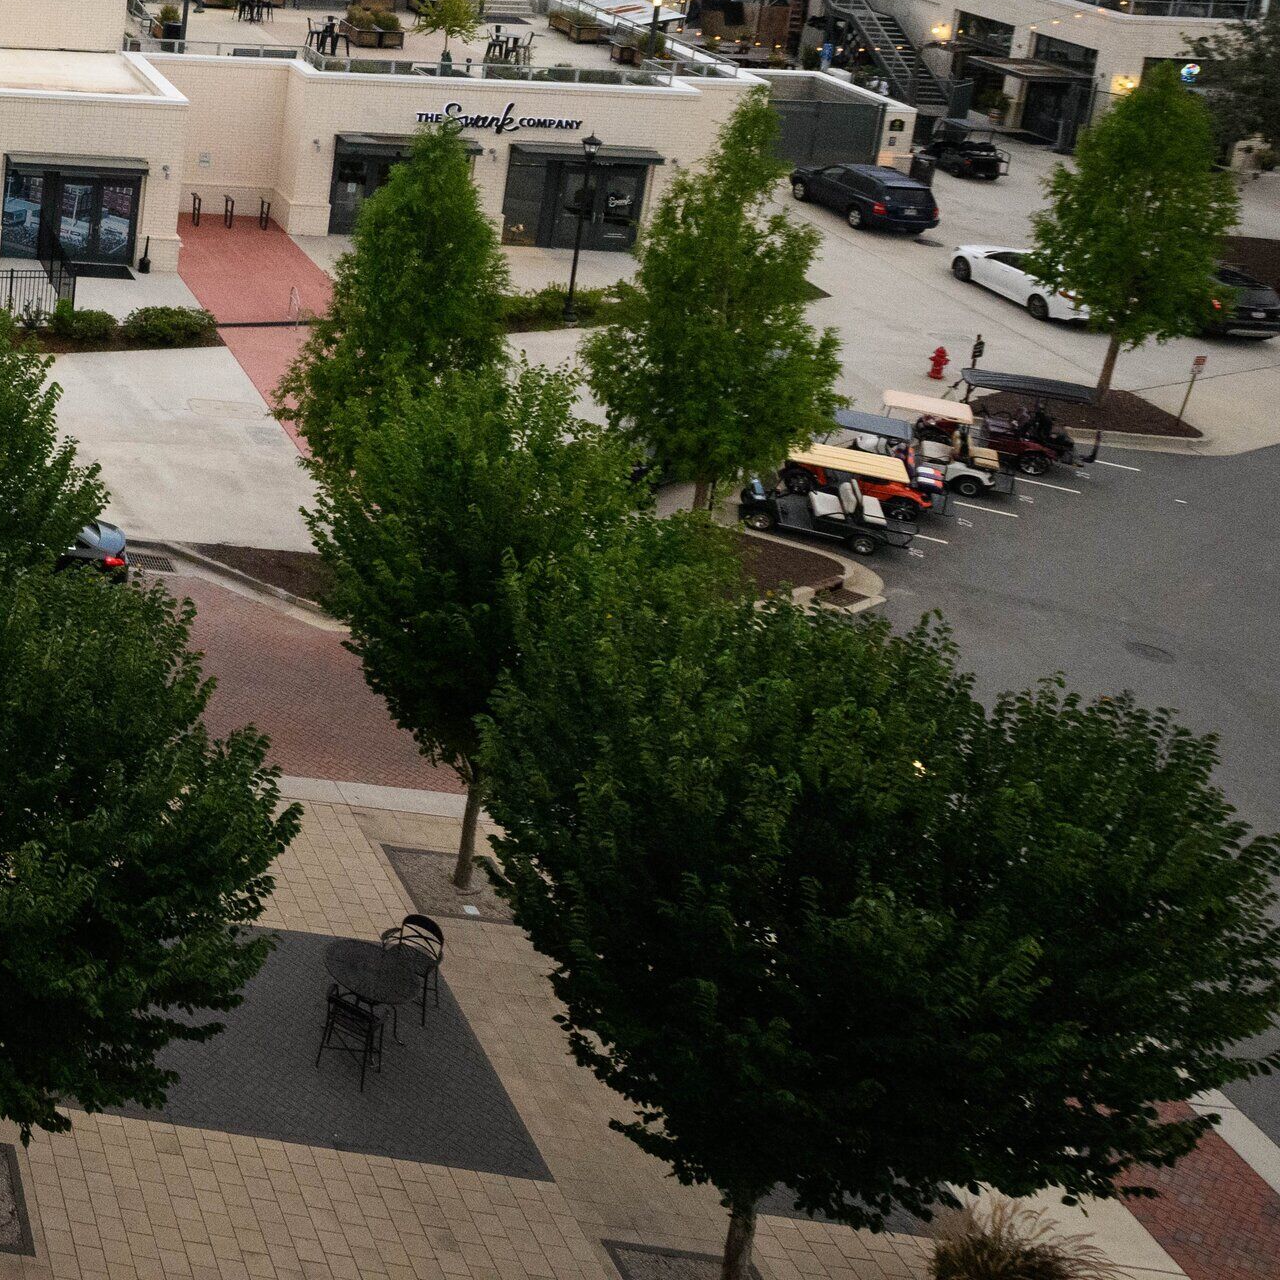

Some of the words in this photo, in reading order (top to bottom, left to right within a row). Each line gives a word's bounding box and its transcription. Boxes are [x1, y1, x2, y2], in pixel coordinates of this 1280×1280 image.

[416, 112, 443, 123] THE
[444, 102, 520, 135] Swank
[519, 117, 583, 130] COMPANY
